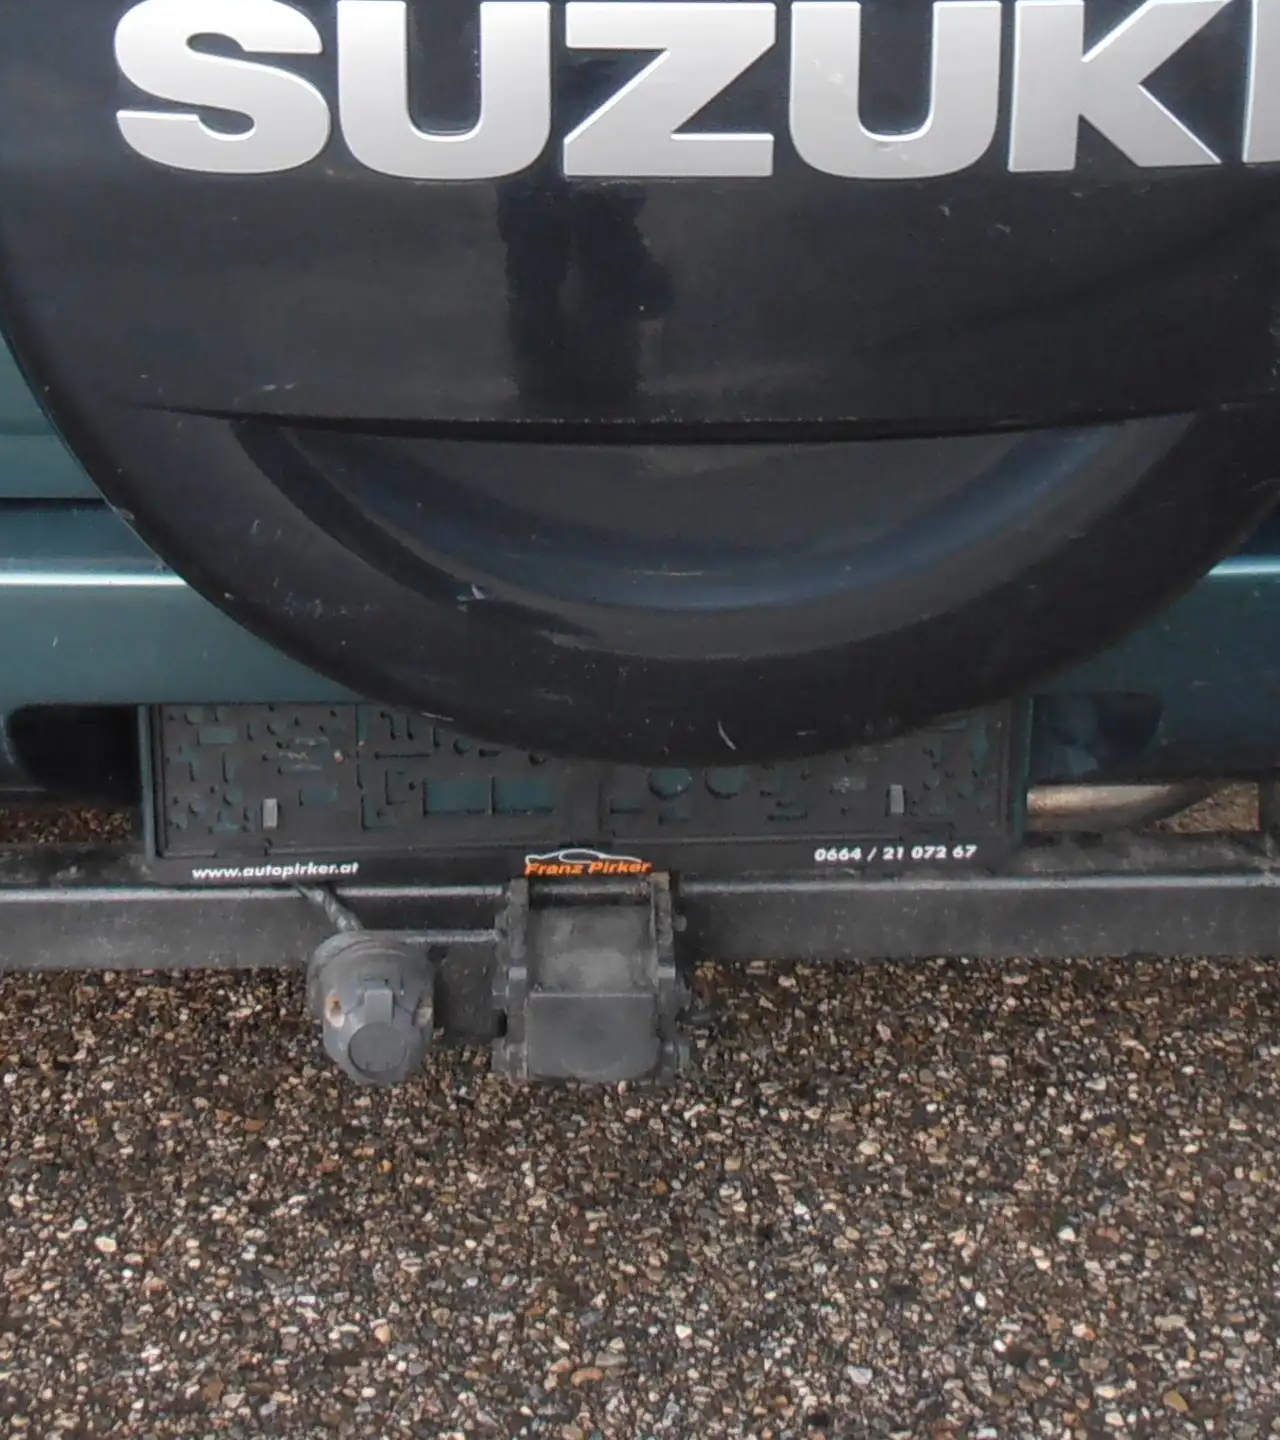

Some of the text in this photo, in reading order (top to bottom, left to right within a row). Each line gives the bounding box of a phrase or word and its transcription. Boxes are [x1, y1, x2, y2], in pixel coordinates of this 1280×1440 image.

[814, 844, 977, 862] 0664 / 21 072 67
[191, 861, 359, 880] www.autopirker.at
[525, 861, 651, 875] Franz Pirker
